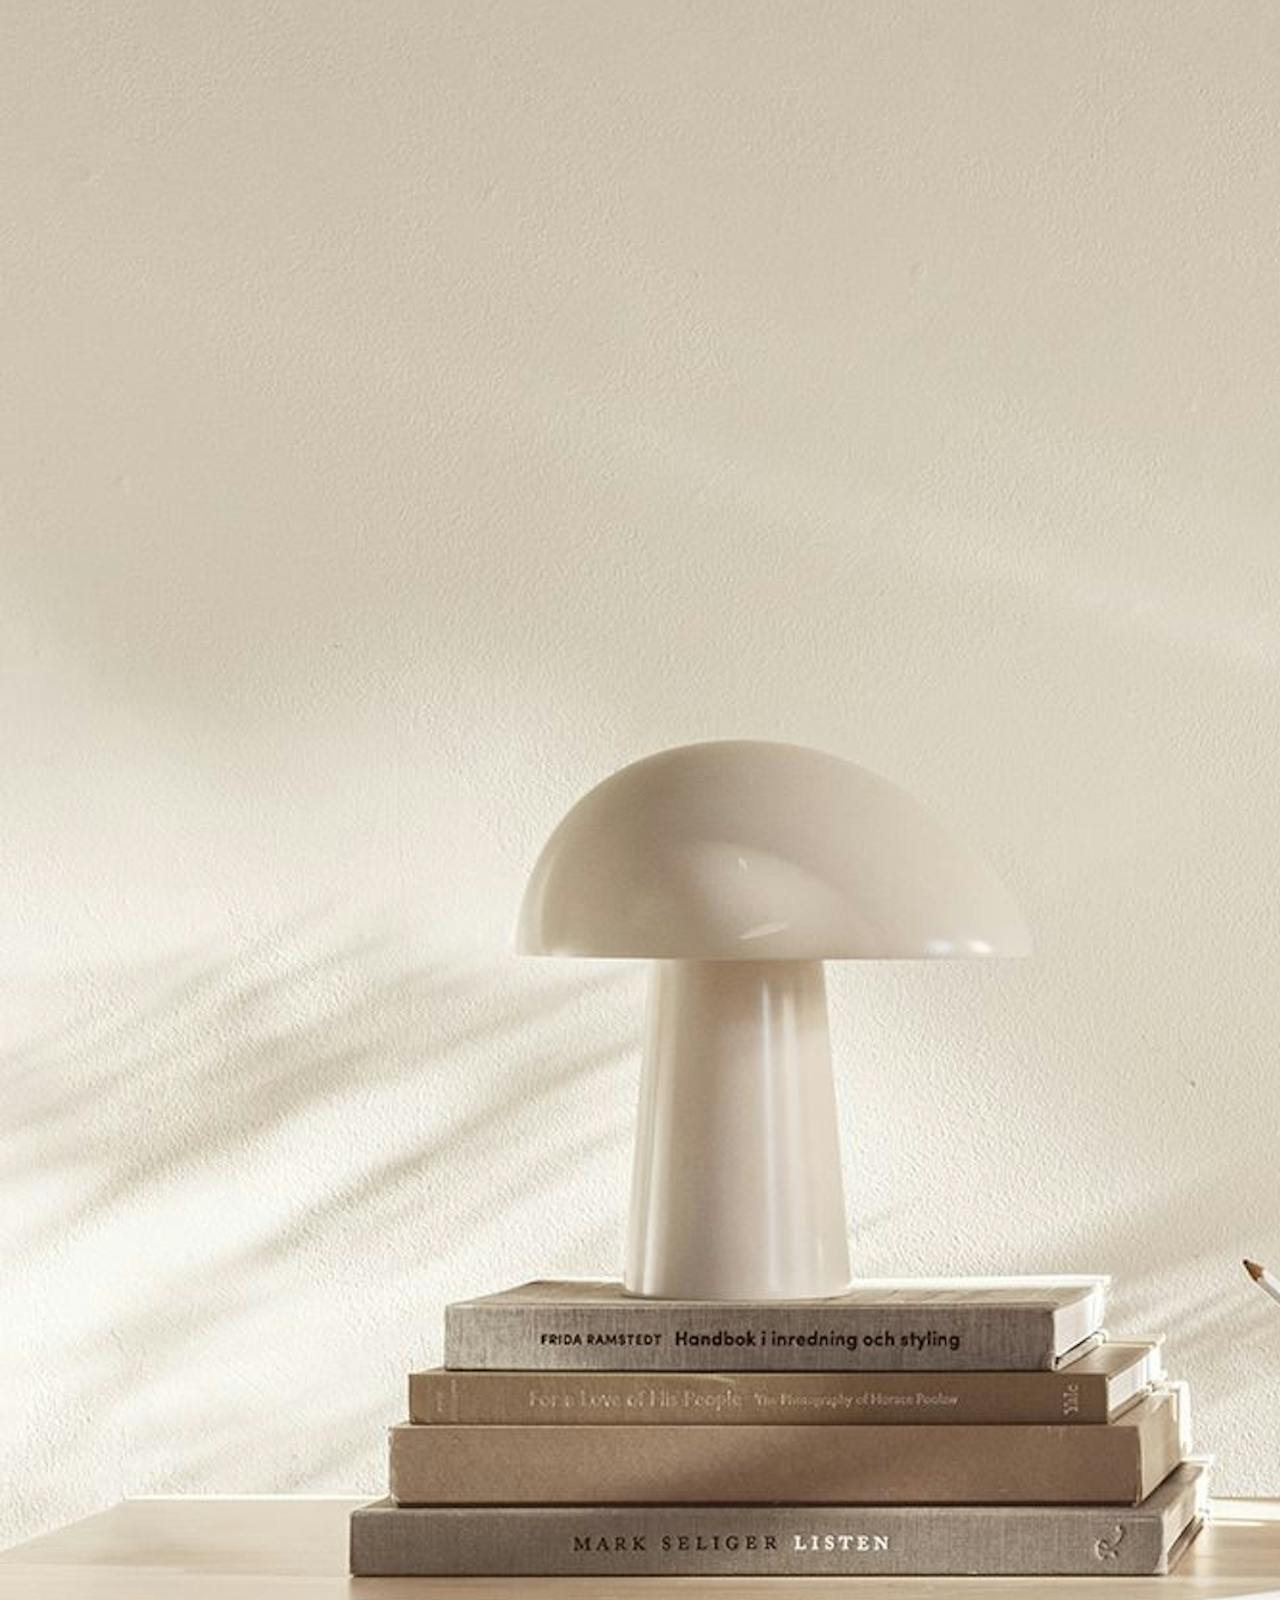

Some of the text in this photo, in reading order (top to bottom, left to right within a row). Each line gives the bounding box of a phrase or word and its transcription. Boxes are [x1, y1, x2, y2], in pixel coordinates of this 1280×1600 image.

[540, 1330, 961, 1351] FRIDA RAMSTEDT Handbok i inredning och styling
[572, 1534, 891, 1552] MARK SELIGER LISTEN
